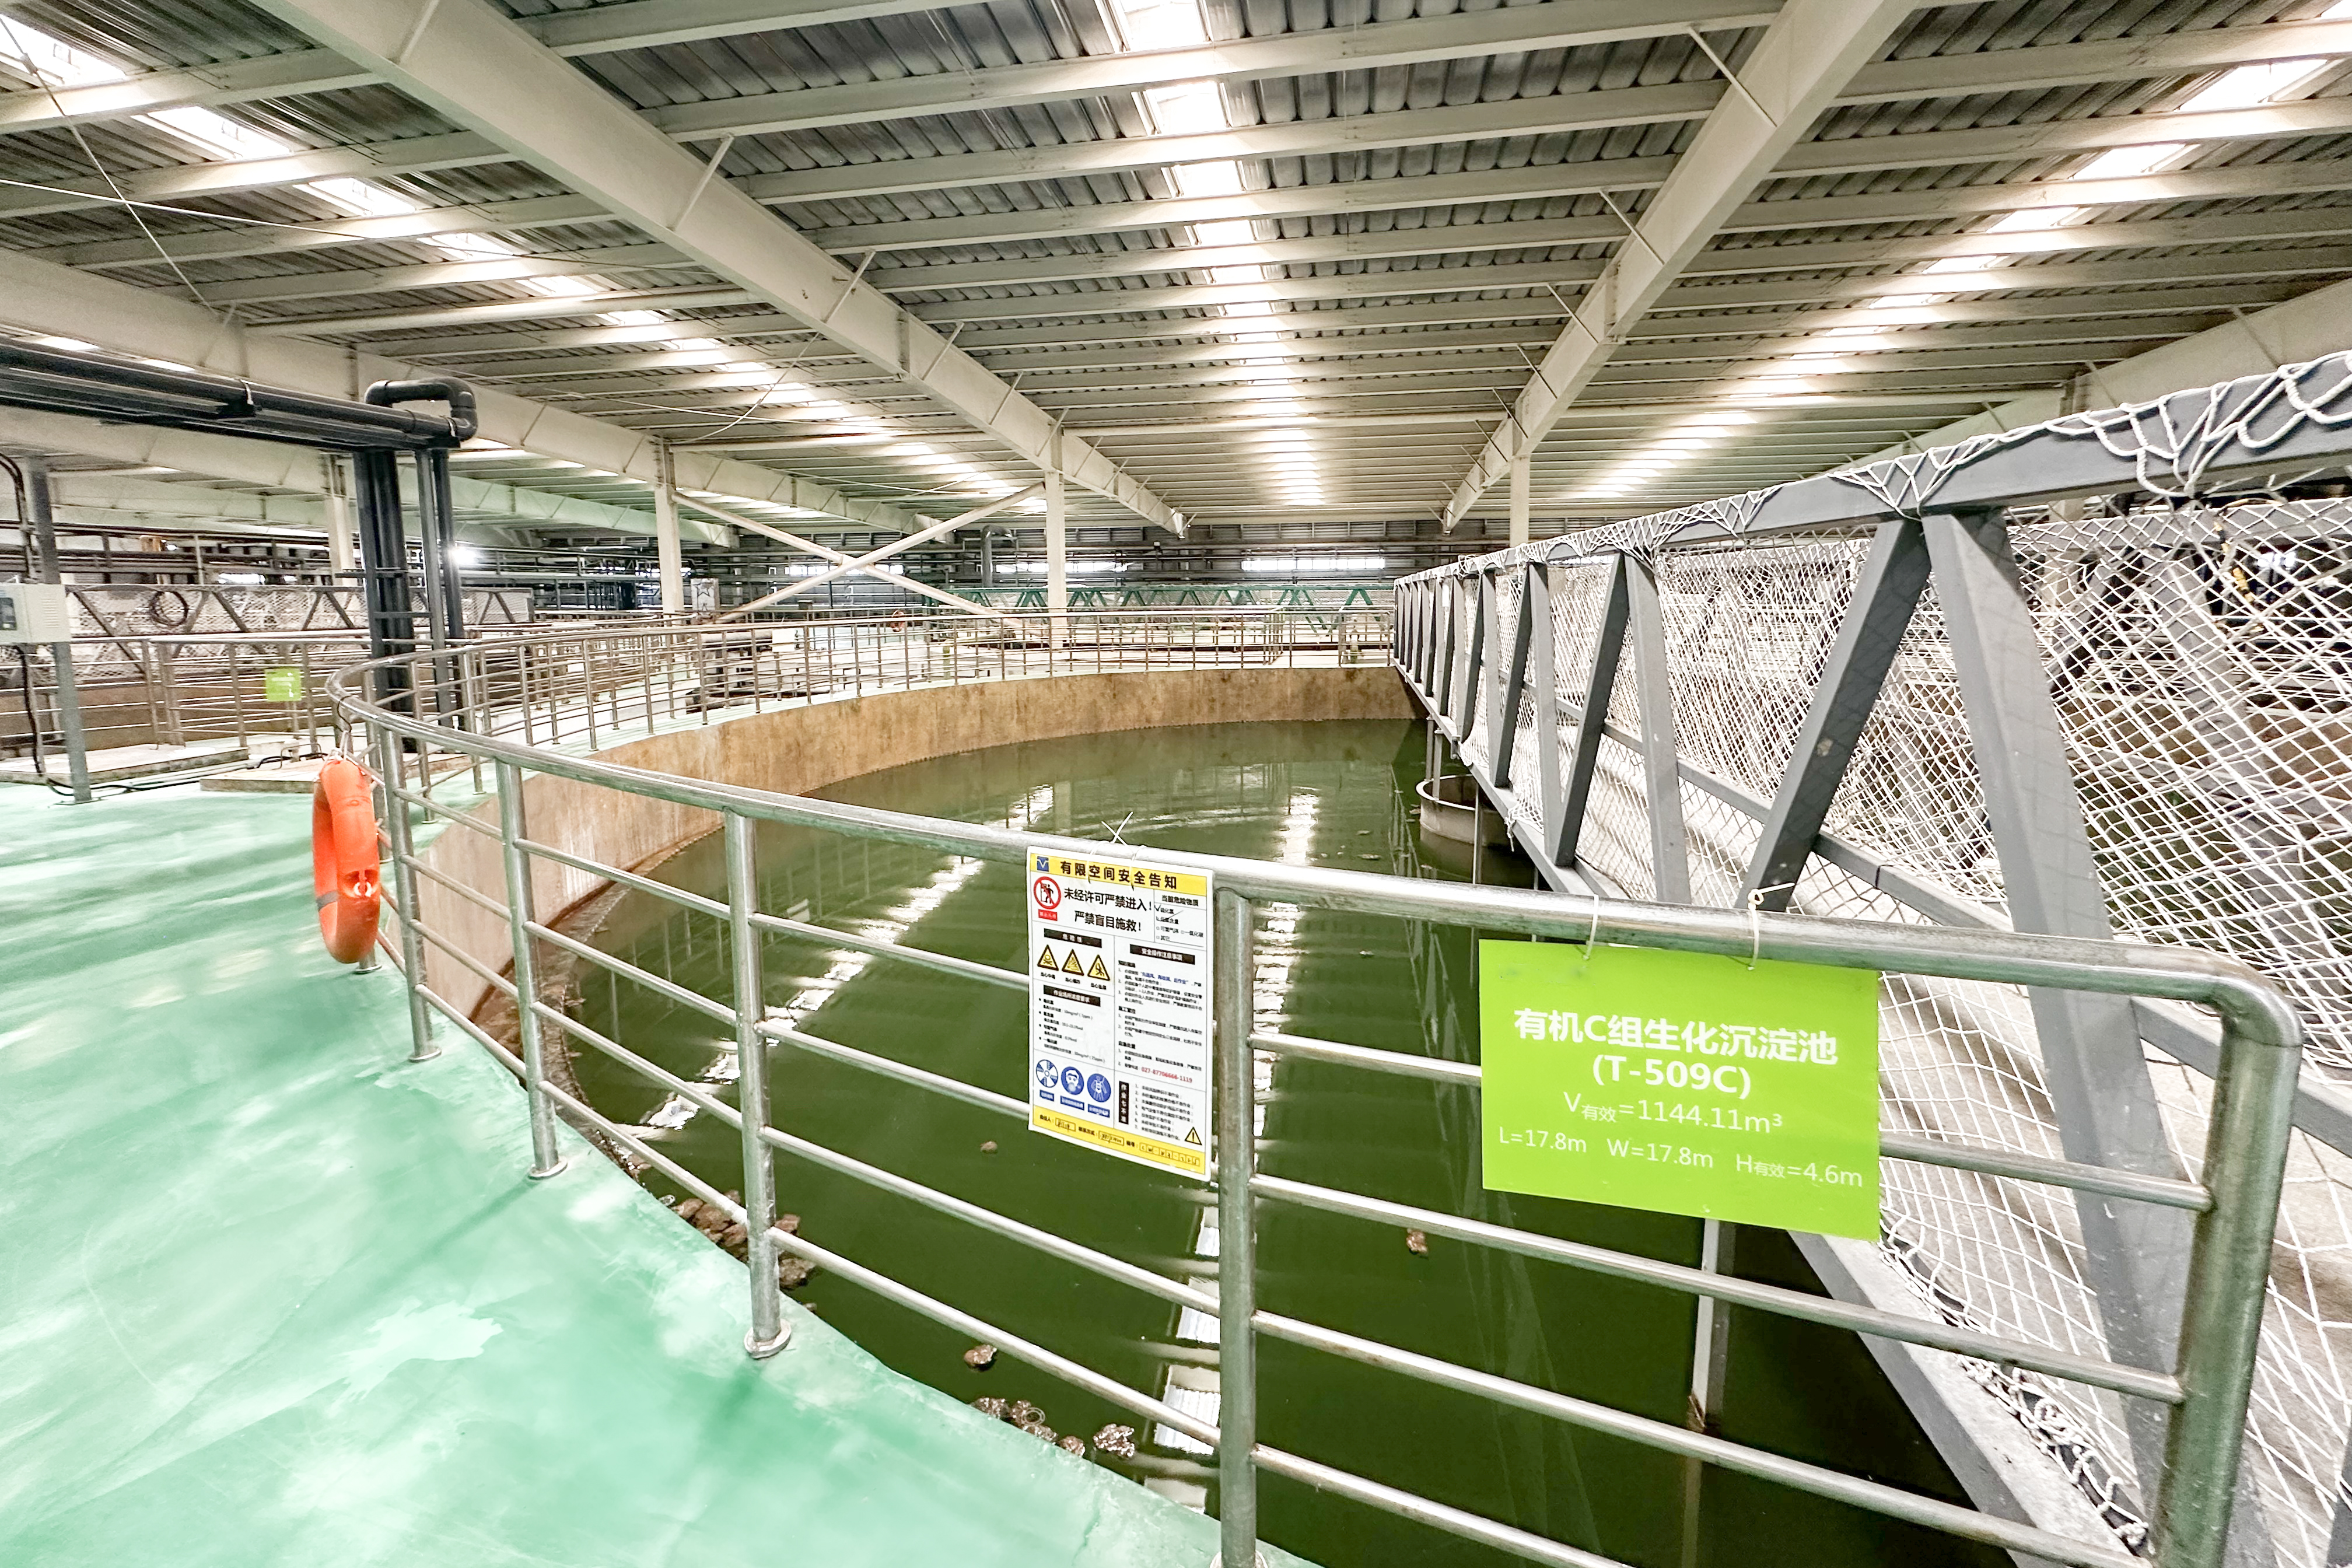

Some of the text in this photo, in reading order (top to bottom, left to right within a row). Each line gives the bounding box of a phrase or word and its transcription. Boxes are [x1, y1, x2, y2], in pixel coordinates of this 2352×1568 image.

[1060, 861, 1177, 889] 有限空间安全告知
[1514, 1008, 1839, 1065] 有机C组生化沉淀池
[1593, 1054, 1751, 1100] (T-509C)
[1500, 1126, 1863, 1188] L=17.8m W=17.8m H有效=4.6m
